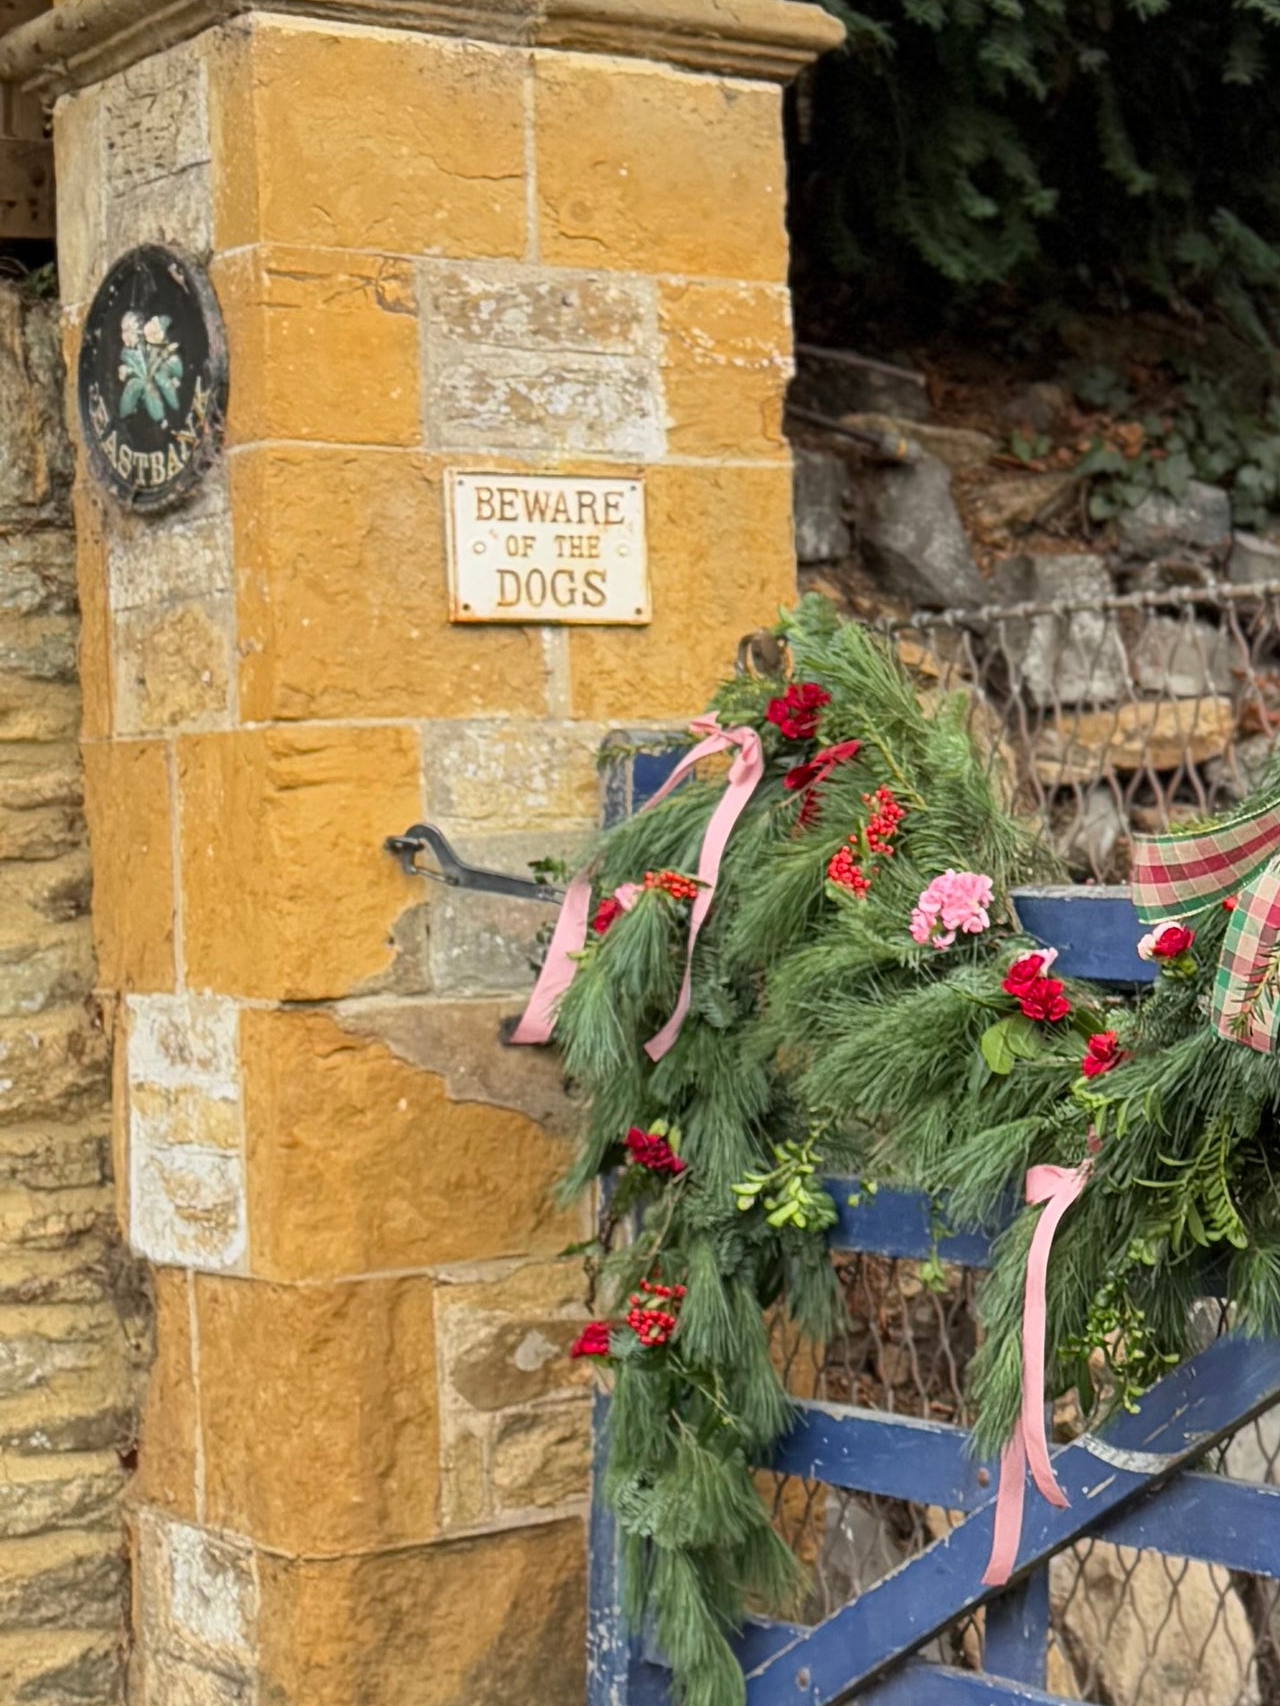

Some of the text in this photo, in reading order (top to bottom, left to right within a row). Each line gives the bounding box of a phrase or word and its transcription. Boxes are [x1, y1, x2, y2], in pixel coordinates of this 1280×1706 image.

[474, 486, 625, 525] BEWARE
[506, 534, 600, 559] OF THE
[496, 568, 607, 608] DOGS
